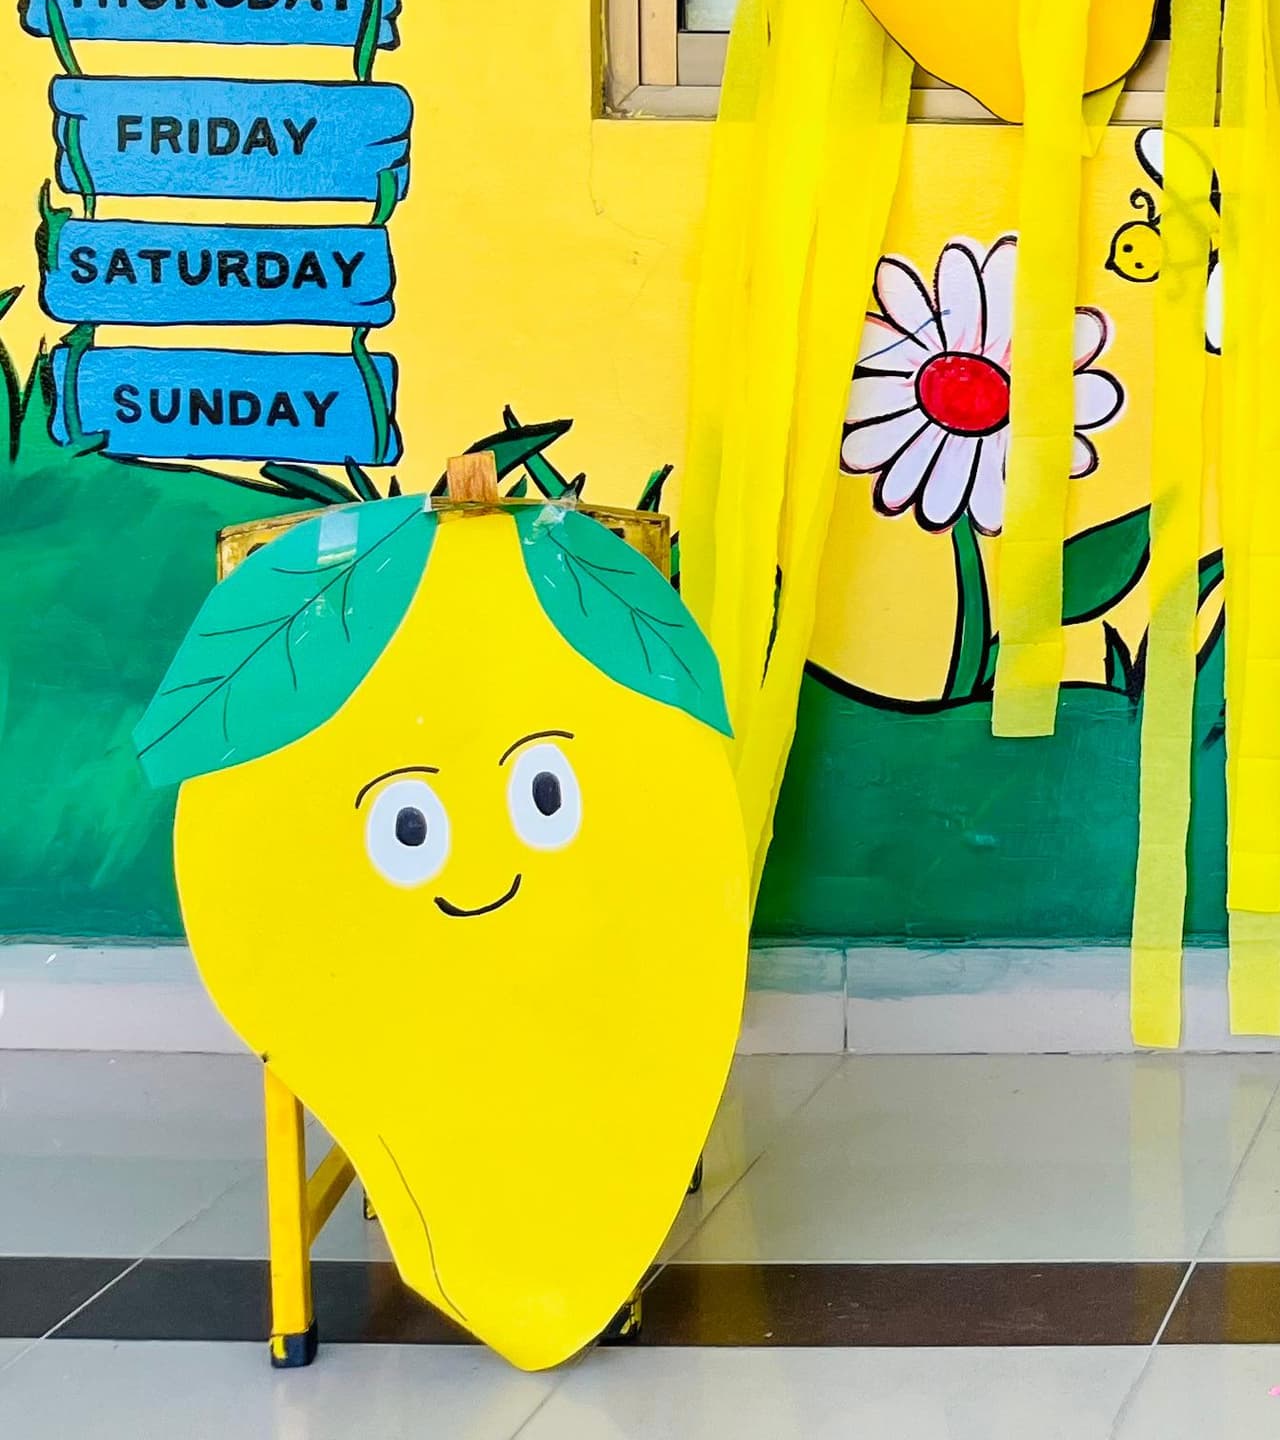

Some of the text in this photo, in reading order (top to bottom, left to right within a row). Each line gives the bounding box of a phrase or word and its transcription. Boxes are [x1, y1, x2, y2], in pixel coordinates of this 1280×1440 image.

[118, 115, 317, 157] FRIDAY
[71, 247, 364, 289] SATURDAY
[115, 387, 337, 428] SUNDAY
